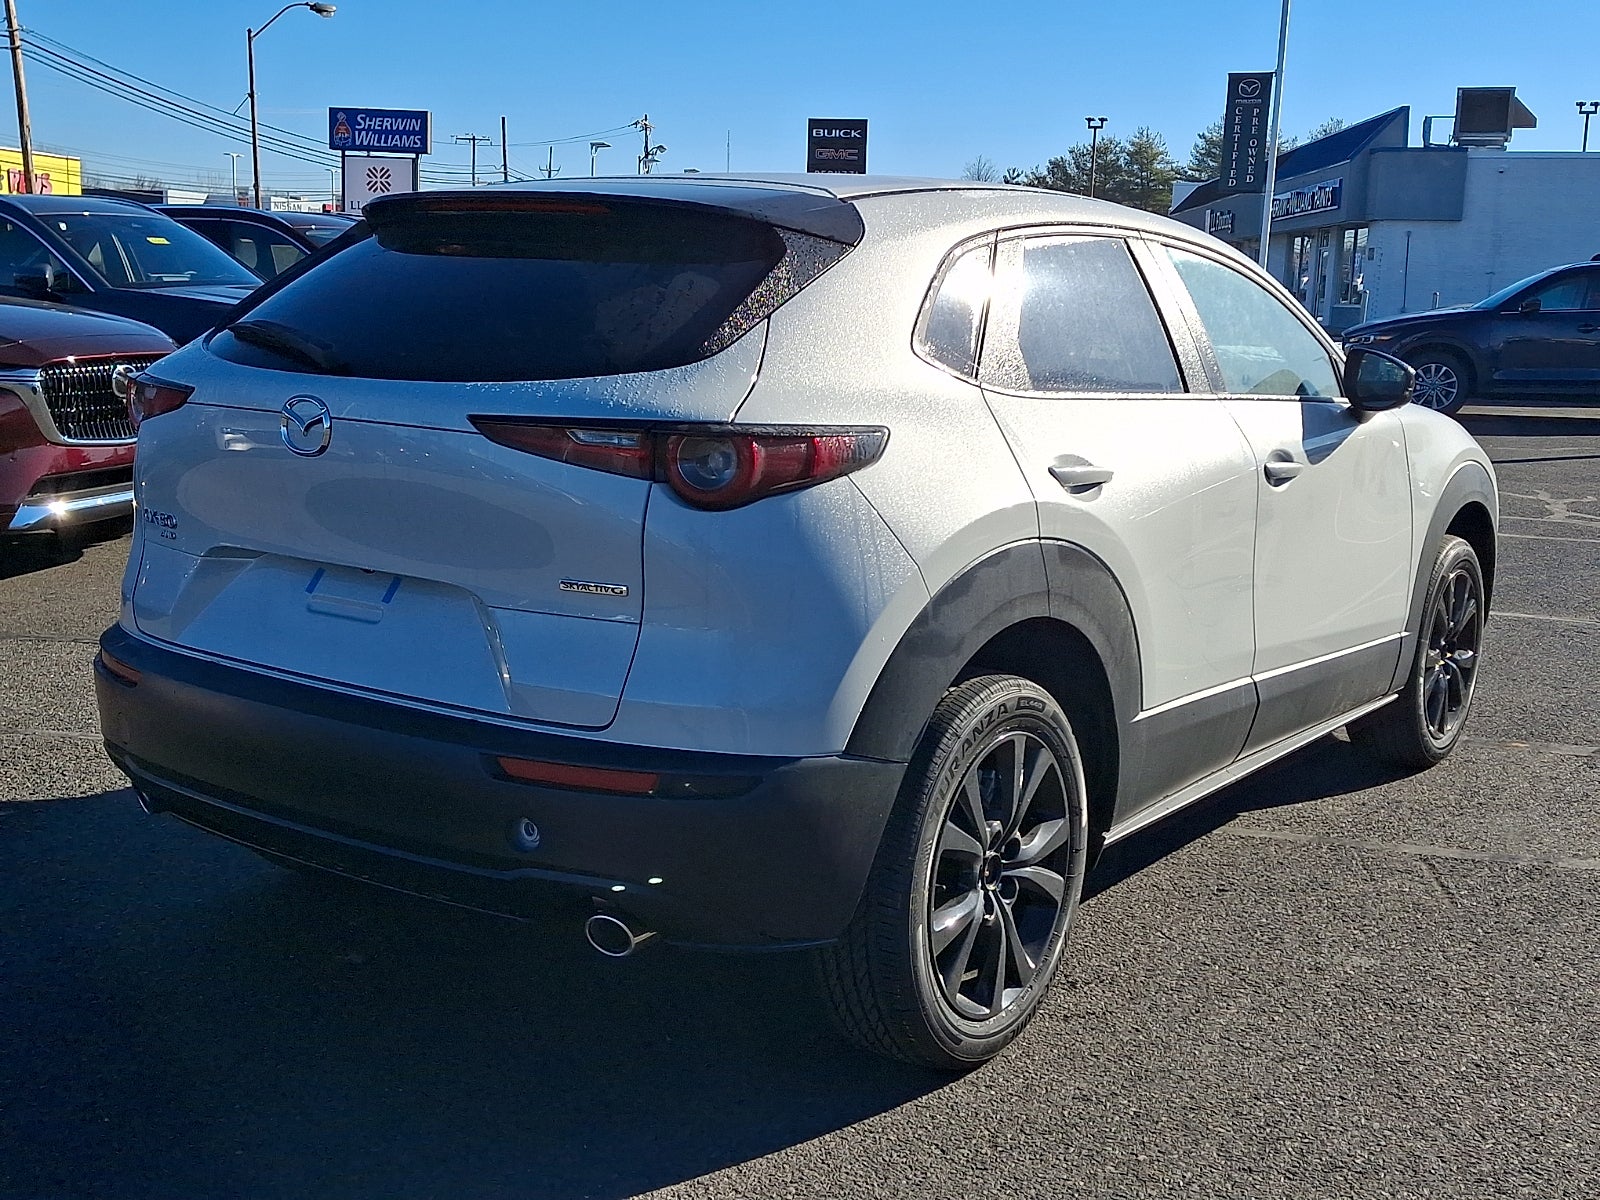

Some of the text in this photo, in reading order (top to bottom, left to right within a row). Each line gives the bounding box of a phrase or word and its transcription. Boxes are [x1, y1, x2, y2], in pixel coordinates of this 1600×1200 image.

[355, 114, 422, 131] SHERWIN
[354, 130, 422, 148] WILLIAMS
[812, 128, 862, 138] BUICK
[815, 148, 859, 160] GMC
[1228, 106, 1243, 187] CERTIFIED
[1246, 108, 1260, 183] PRE OWNED
[273, 201, 302, 211] NISSAN
